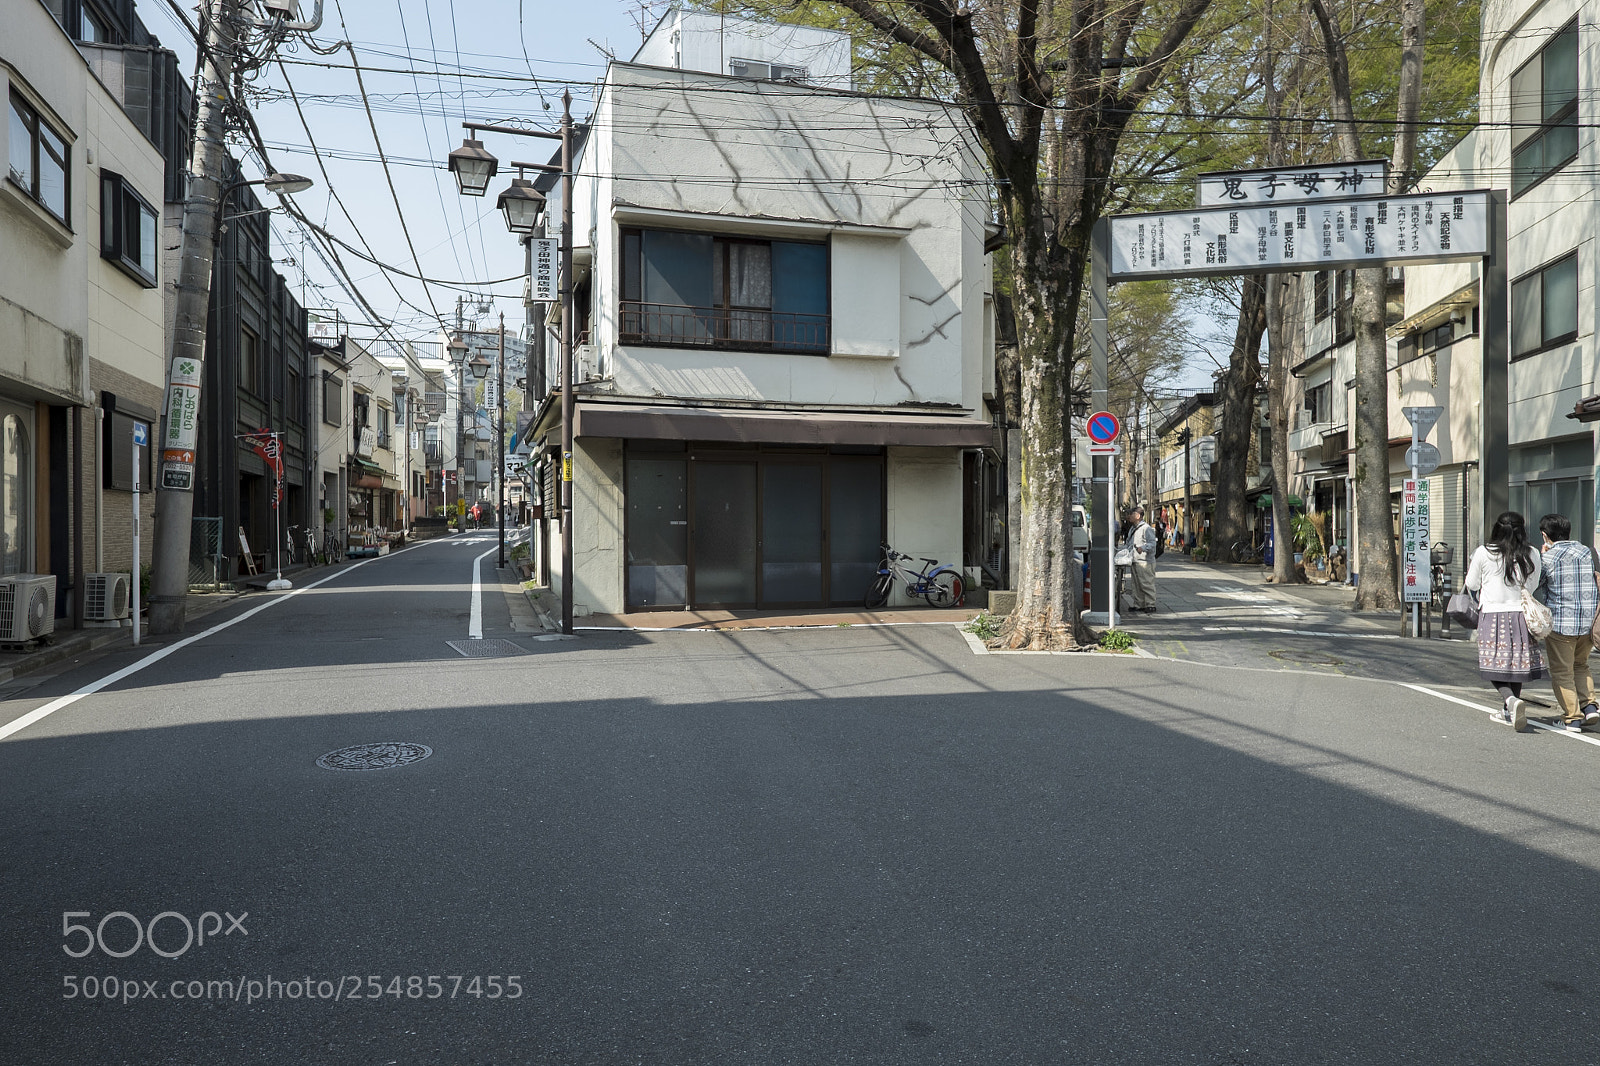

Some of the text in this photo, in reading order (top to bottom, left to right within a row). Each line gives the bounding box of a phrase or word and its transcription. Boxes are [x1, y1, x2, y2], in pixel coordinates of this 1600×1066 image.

[1219, 168, 1364, 200] 鬼子母神
[1229, 212, 1238, 234] 区指定
[1296, 207, 1306, 229] 国指定
[1377, 202, 1387, 224] 都指定
[1453, 197, 1463, 220] 都指定
[1258, 226, 1267, 261] 鬼子母神堂
[1284, 222, 1294, 258] 重要文化財
[1365, 217, 1374, 254] 有形文化財
[1397, 206, 1406, 252] 大門ケヤキ並木
[1440, 212, 1450, 250] 天然記念物
[1206, 242, 1215, 264] 文化財
[1217, 234, 1227, 263] 無形民俗
[169, 387, 184, 440] 内科循環器
[183, 388, 196, 431] しおばら
[167, 440, 193, 448] クリニック
[1405, 481, 1416, 586] 車両は歩行者に注意
[1417, 481, 1429, 551] 通学路につき
